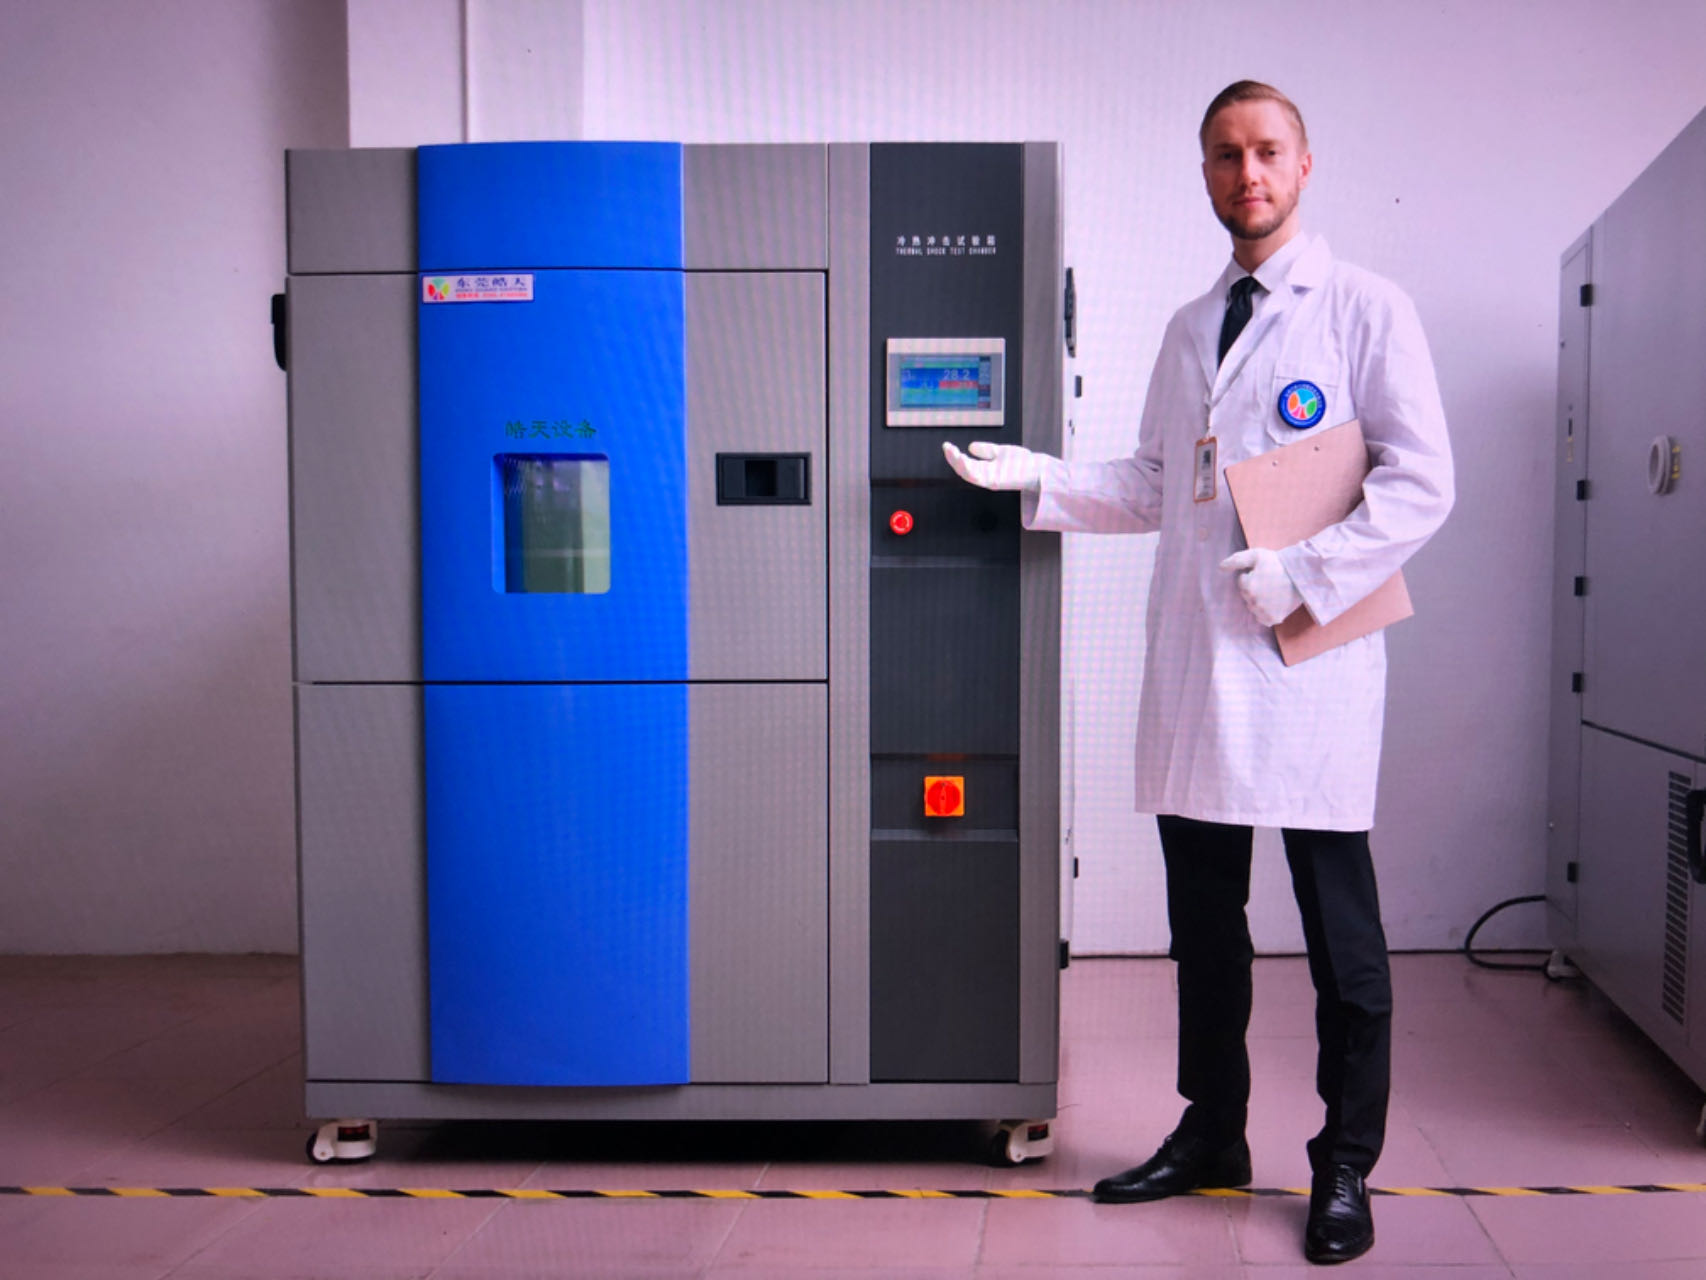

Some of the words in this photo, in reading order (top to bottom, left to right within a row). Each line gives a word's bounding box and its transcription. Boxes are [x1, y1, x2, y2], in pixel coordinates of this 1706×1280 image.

[950, 247, 966, 256] TEST
[504, 419, 597, 439] 皓天设备
